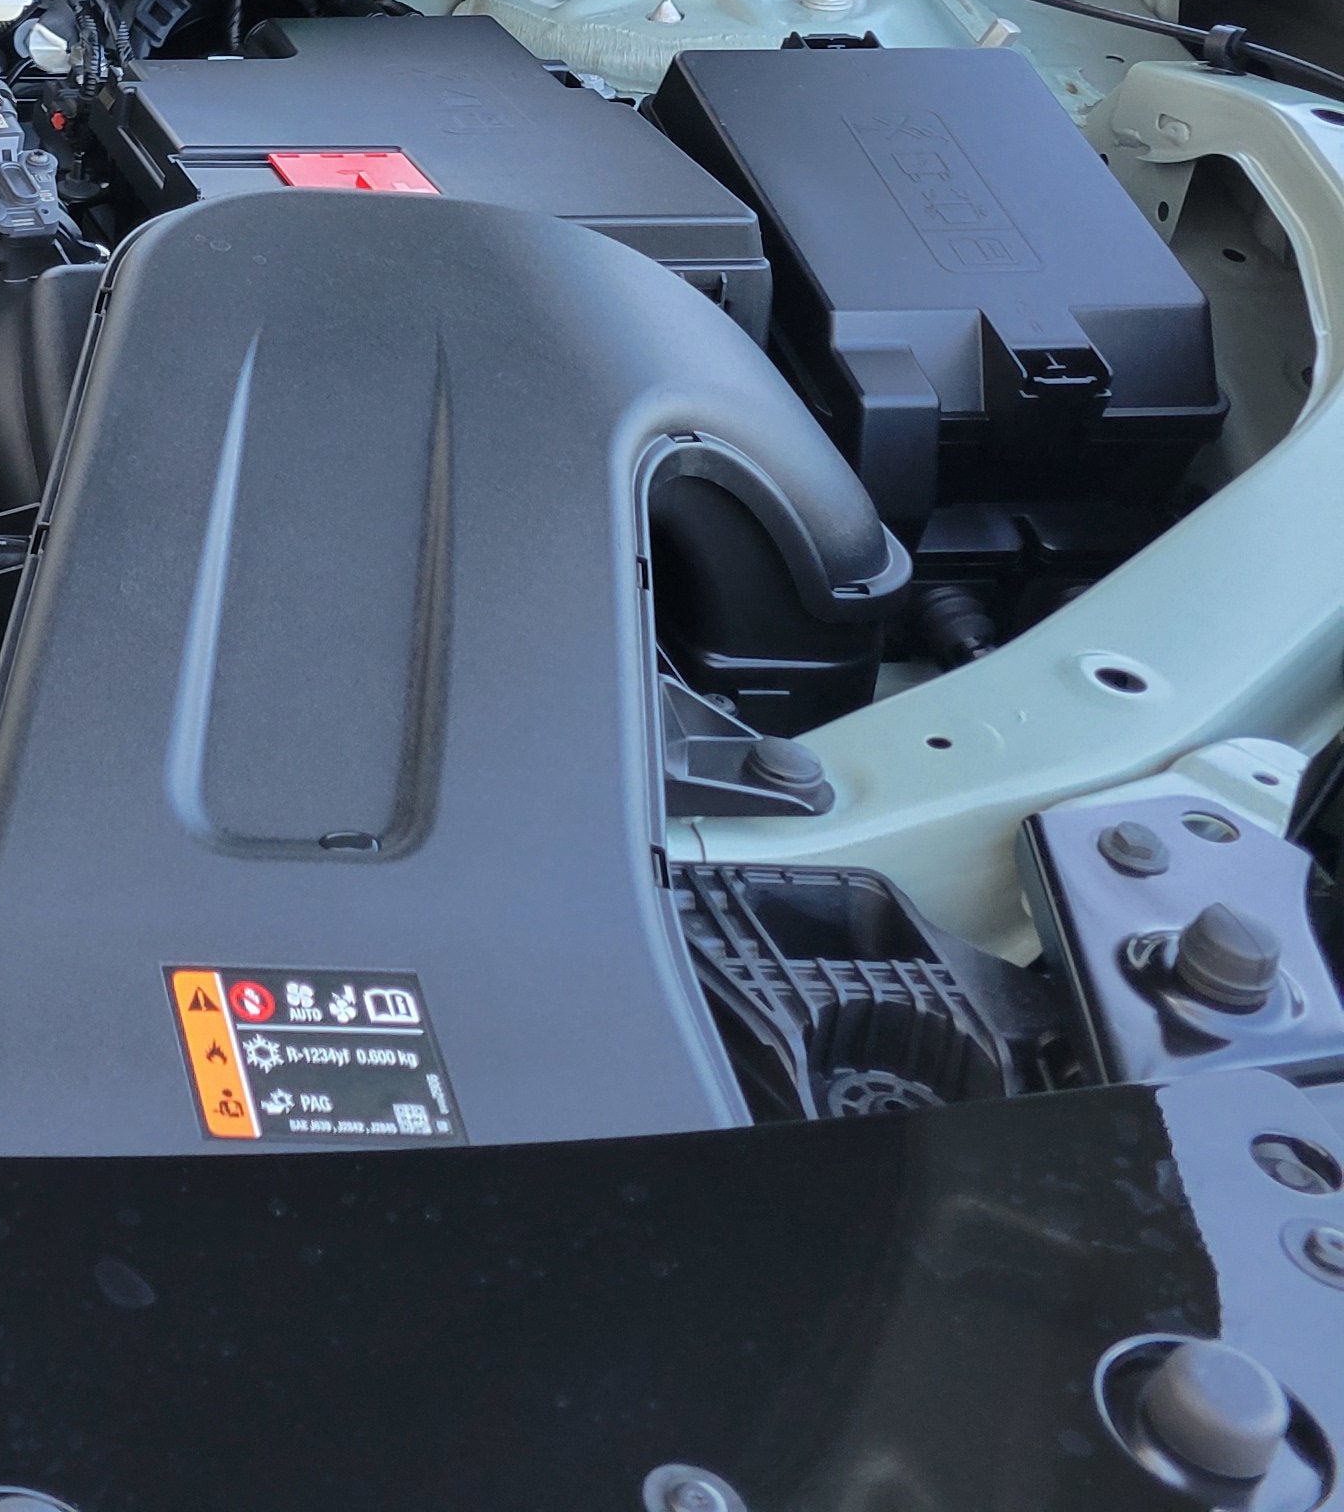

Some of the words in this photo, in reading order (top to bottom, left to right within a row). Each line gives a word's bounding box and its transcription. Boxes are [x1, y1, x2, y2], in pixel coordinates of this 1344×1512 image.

[289, 1008, 323, 1022] AUTO
[286, 1045, 351, 1068] R-1234yf
[397, 1049, 419, 1070] kg
[299, 1093, 334, 1114] PAG
